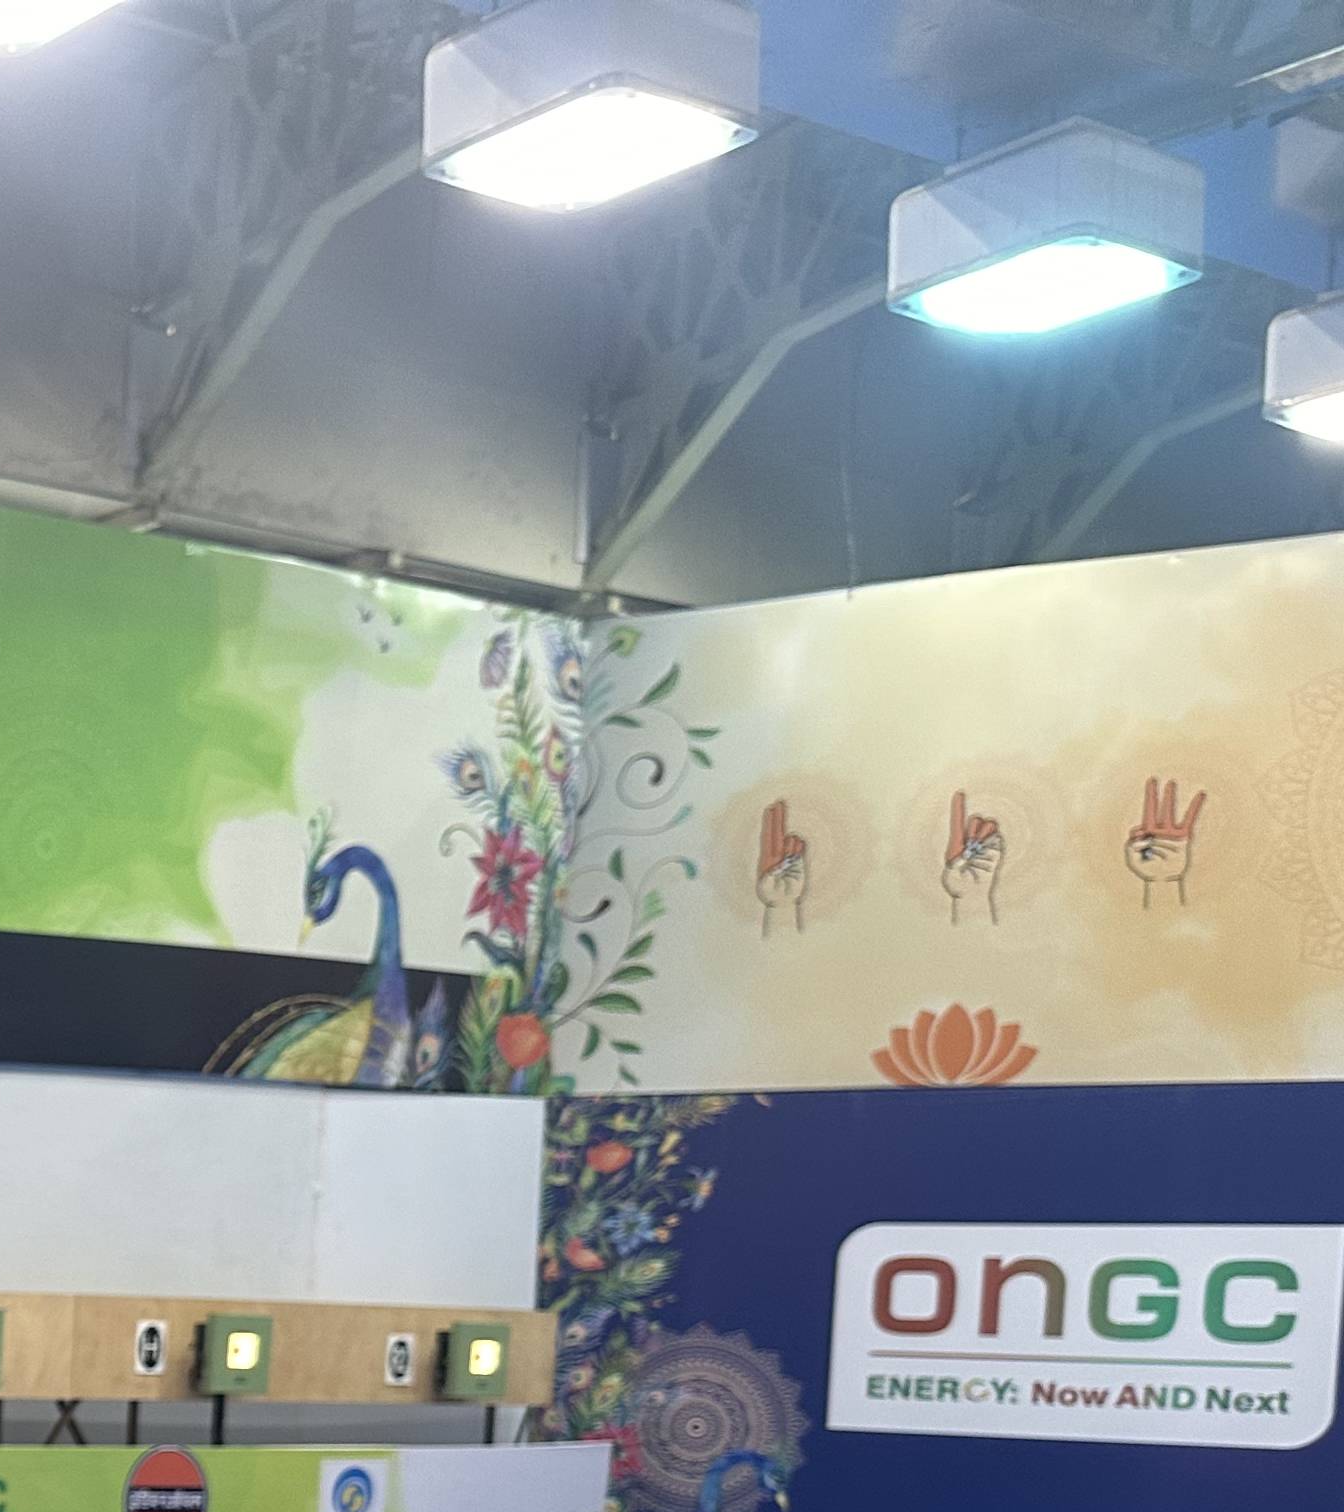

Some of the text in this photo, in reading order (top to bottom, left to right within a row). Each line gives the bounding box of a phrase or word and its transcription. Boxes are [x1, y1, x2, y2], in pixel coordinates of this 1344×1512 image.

[141, 1332, 160, 1363] H
[1031, 1380, 1109, 1409] Now
[1115, 1383, 1194, 1411] AND
[1206, 1387, 1290, 1416] Next
